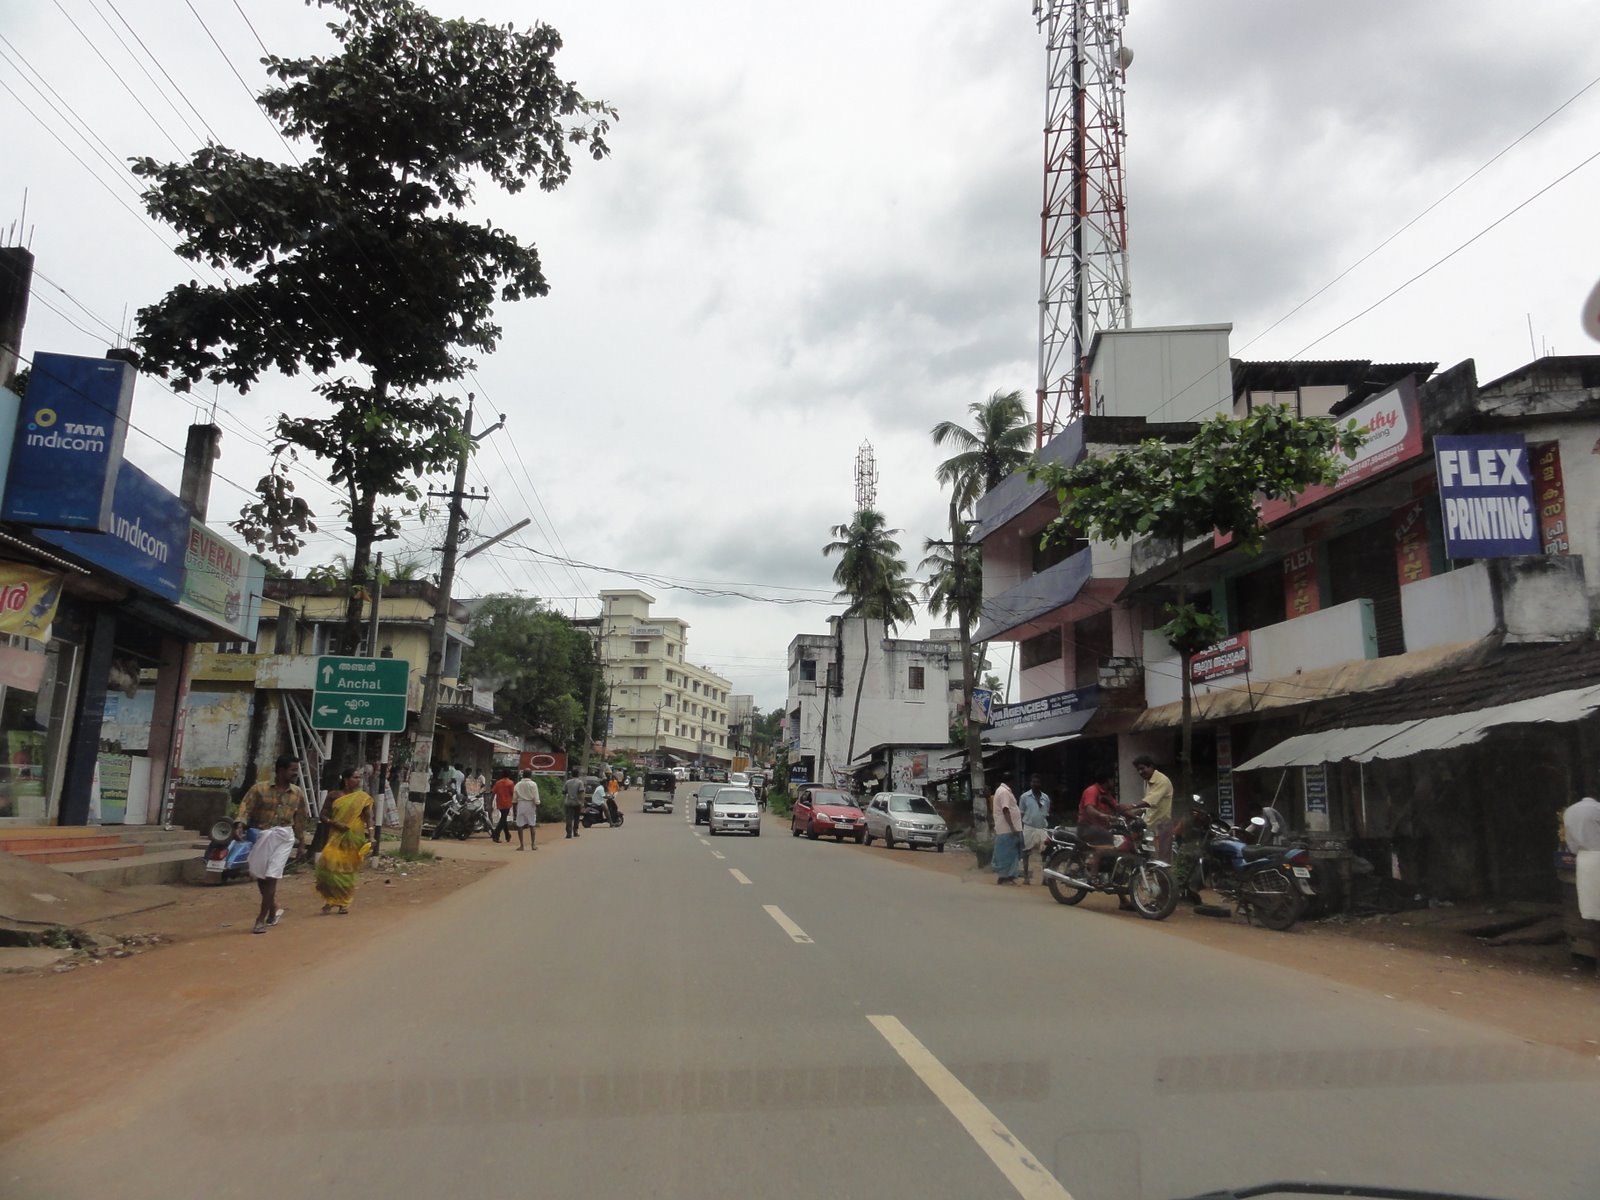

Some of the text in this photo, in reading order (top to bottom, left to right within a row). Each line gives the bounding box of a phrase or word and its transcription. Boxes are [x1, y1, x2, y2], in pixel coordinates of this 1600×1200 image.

[27, 431, 104, 453] indicom
[64, 423, 105, 437] TATA
[1439, 448, 1528, 487] FLEX
[1445, 496, 1534, 541] PRINTING
[116, 517, 168, 563] indicom
[187, 527, 242, 581] EVERAJ
[1283, 549, 1314, 575] FLEX
[337, 678, 381, 690] Anchal
[343, 714, 385, 726] Aeram
[1003, 700, 1049, 719] AGENCIES
